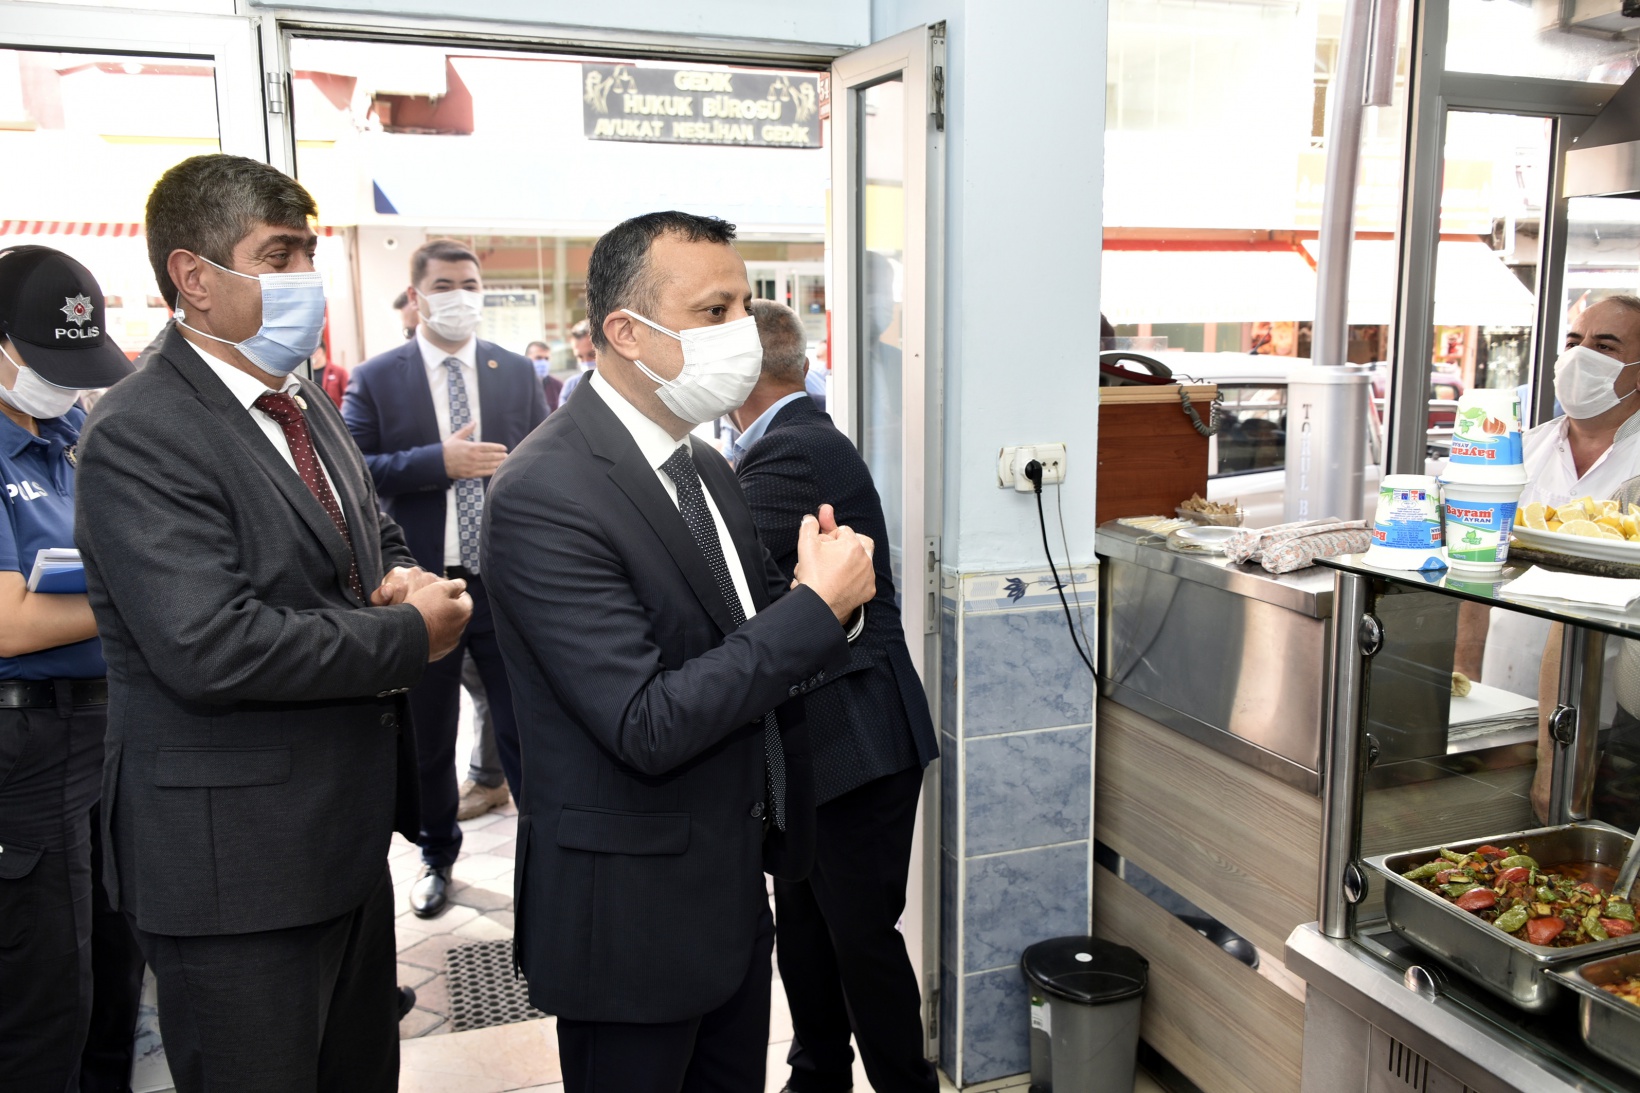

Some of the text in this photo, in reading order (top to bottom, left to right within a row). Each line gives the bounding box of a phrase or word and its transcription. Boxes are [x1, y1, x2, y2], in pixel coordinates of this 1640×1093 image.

[623, 94, 693, 116] HUKUK
[594, 118, 664, 137] AVUKAT
[672, 120, 754, 141] NESLİHAN
[1446, 505, 1492, 518] Bayram
